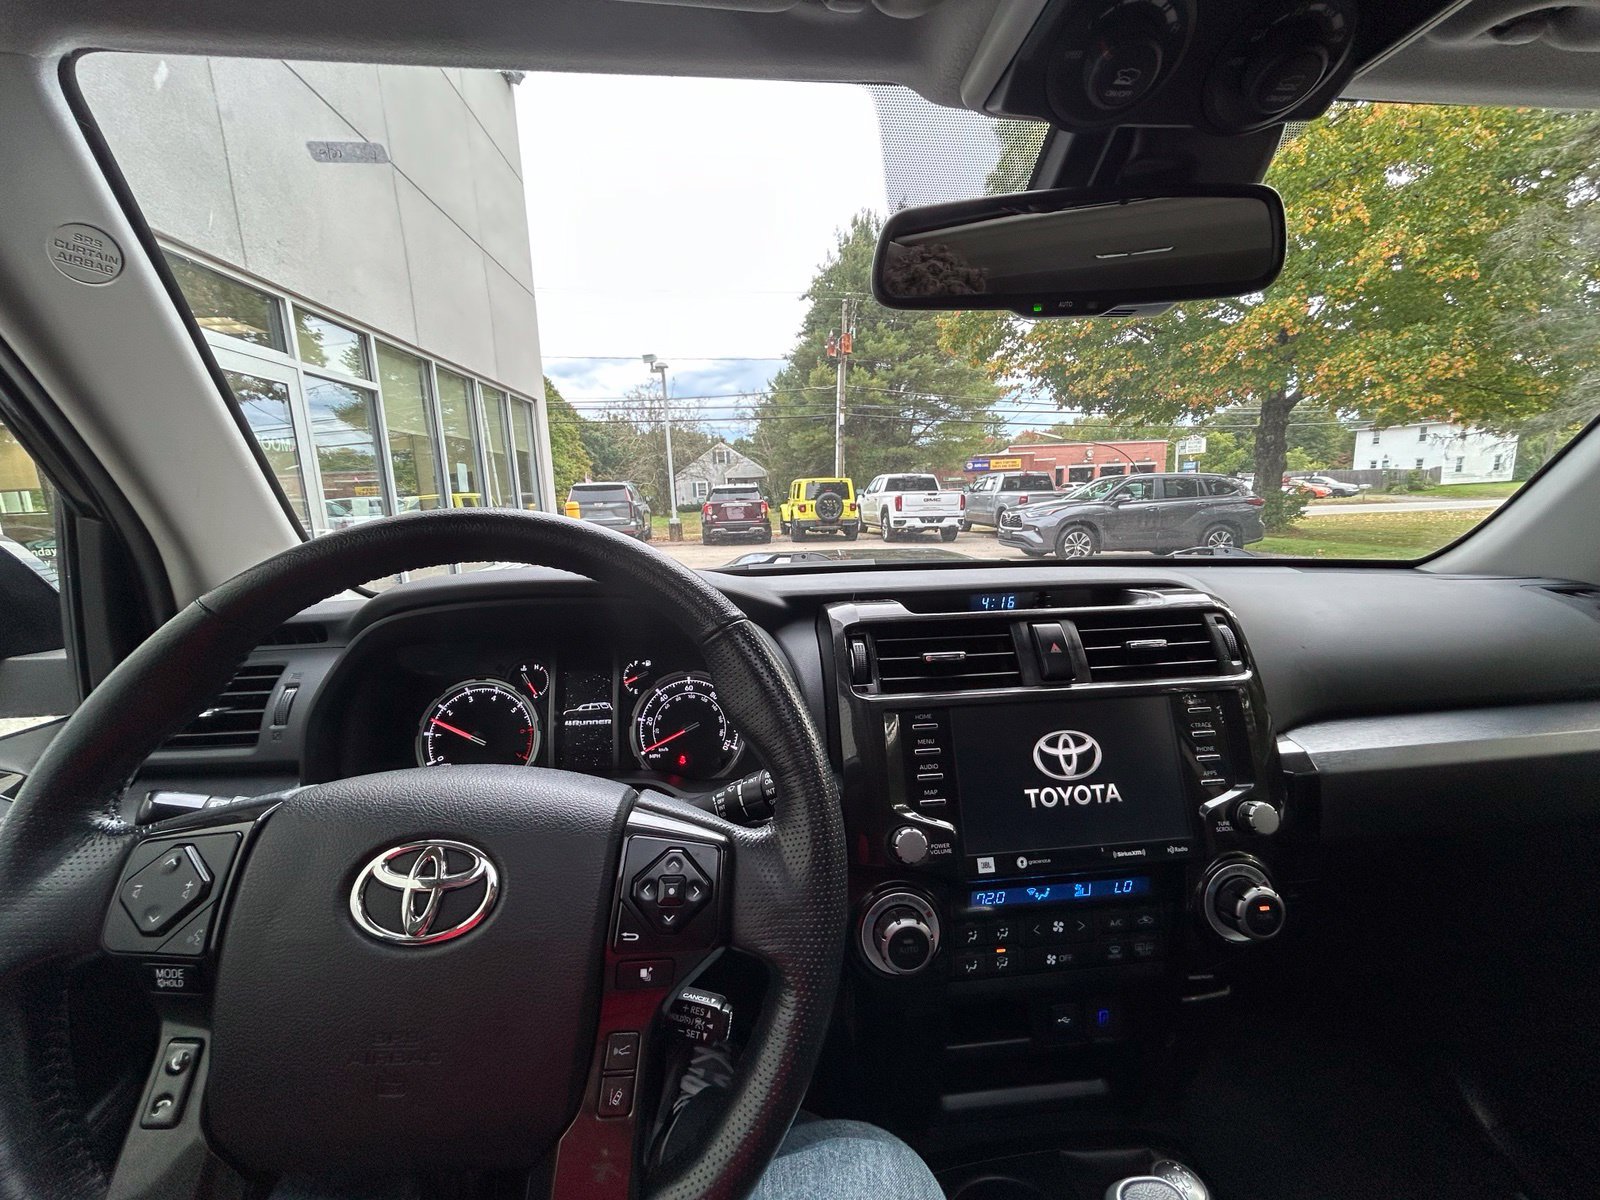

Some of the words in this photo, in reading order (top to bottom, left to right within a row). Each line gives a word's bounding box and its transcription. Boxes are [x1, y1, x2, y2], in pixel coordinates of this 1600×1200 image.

[73, 233, 103, 248] SRS
[54, 239, 118, 265] CURTAIN
[58, 252, 114, 274] AIRBAG
[32, 547, 57, 557] nday
[982, 596, 1015, 609] 4:16
[660, 694, 669, 702] 40
[646, 717, 654, 726] 20
[723, 740, 731, 751] 120
[766, 787, 775, 796] INT
[1024, 783, 1123, 808] TOYOTA
[977, 892, 1006, 905] 72.0
[1110, 919, 1123, 927] A/C
[1059, 954, 1072, 962] OFF
[156, 969, 184, 979] MODE
[683, 993, 710, 1003] CANCEL
[690, 1006, 705, 1016] RES
[686, 1029, 700, 1039] SET
